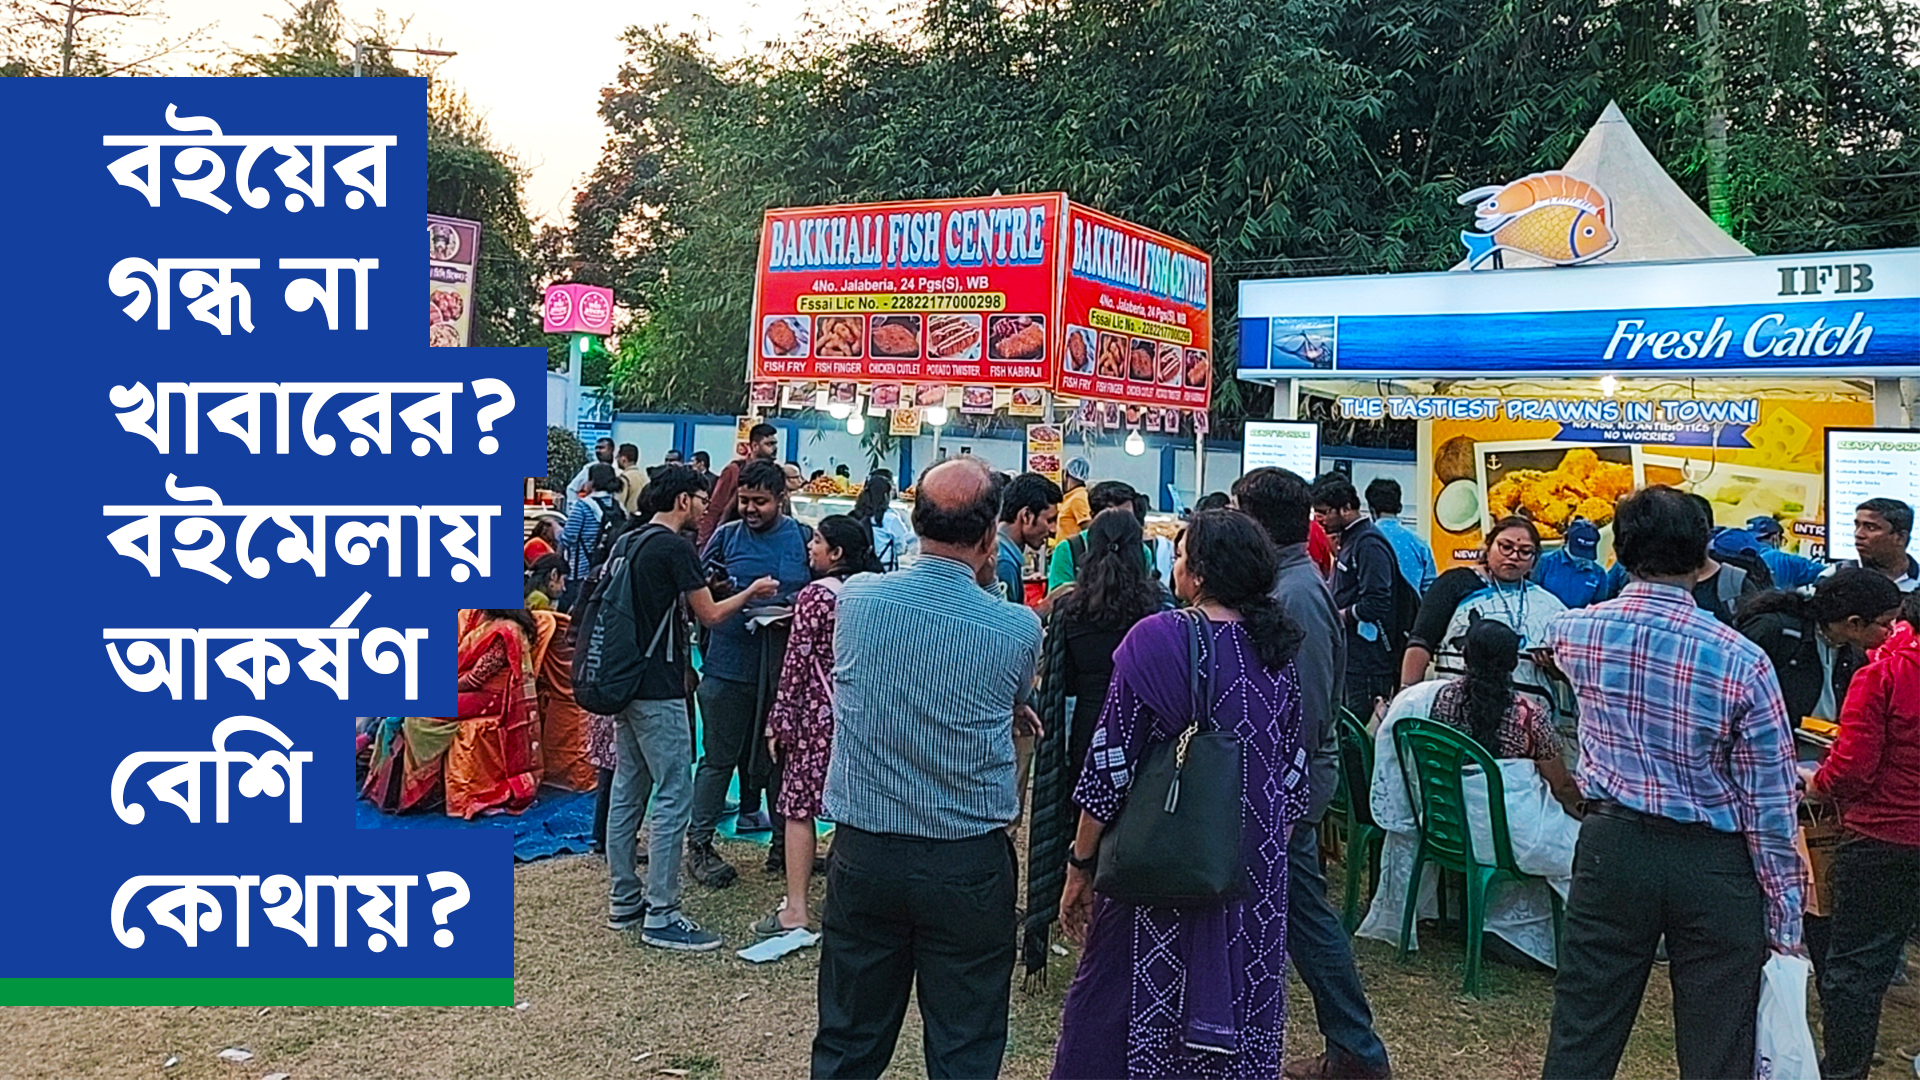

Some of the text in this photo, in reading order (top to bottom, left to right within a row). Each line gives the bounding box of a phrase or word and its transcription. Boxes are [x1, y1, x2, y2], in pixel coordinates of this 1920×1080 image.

[769, 206, 1046, 271] BAKKHALI FISH CENTRE
[1072, 218, 1144, 291] BAKKHALI
[1142, 241, 1171, 299] FISH
[812, 276, 989, 293] 4No. Jalaberia, 24 Pgs(S), WB
[1777, 263, 1874, 296] IFB
[800, 297, 833, 310] Fssai
[836, 297, 854, 310] Lic
[858, 297, 879, 309] No.
[891, 295, 1001, 309] 22822177000298
[1091, 311, 1111, 327] Fssai
[1602, 311, 1874, 360] Fresh Catch
[764, 361, 783, 372] FISH
[787, 361, 807, 372] FRY
[815, 362, 832, 373] FISH
[833, 362, 862, 373] FINGER
[869, 363, 895, 374] CHICKEN
[897, 363, 920, 375] CUTLET
[926, 364, 951, 375] POTATO
[990, 365, 1006, 377] FISH
[1063, 376, 1078, 388] FISH
[1079, 378, 1092, 391] FRY
[1341, 398, 1759, 424] THE TASTIEST PRAWNS IN TOWN!
[1604, 431, 1675, 442] NO WORRIES
[1837, 441, 1874, 451] READY
[1880, 441, 1894, 452] TO
[1454, 549, 1478, 559] NEW
